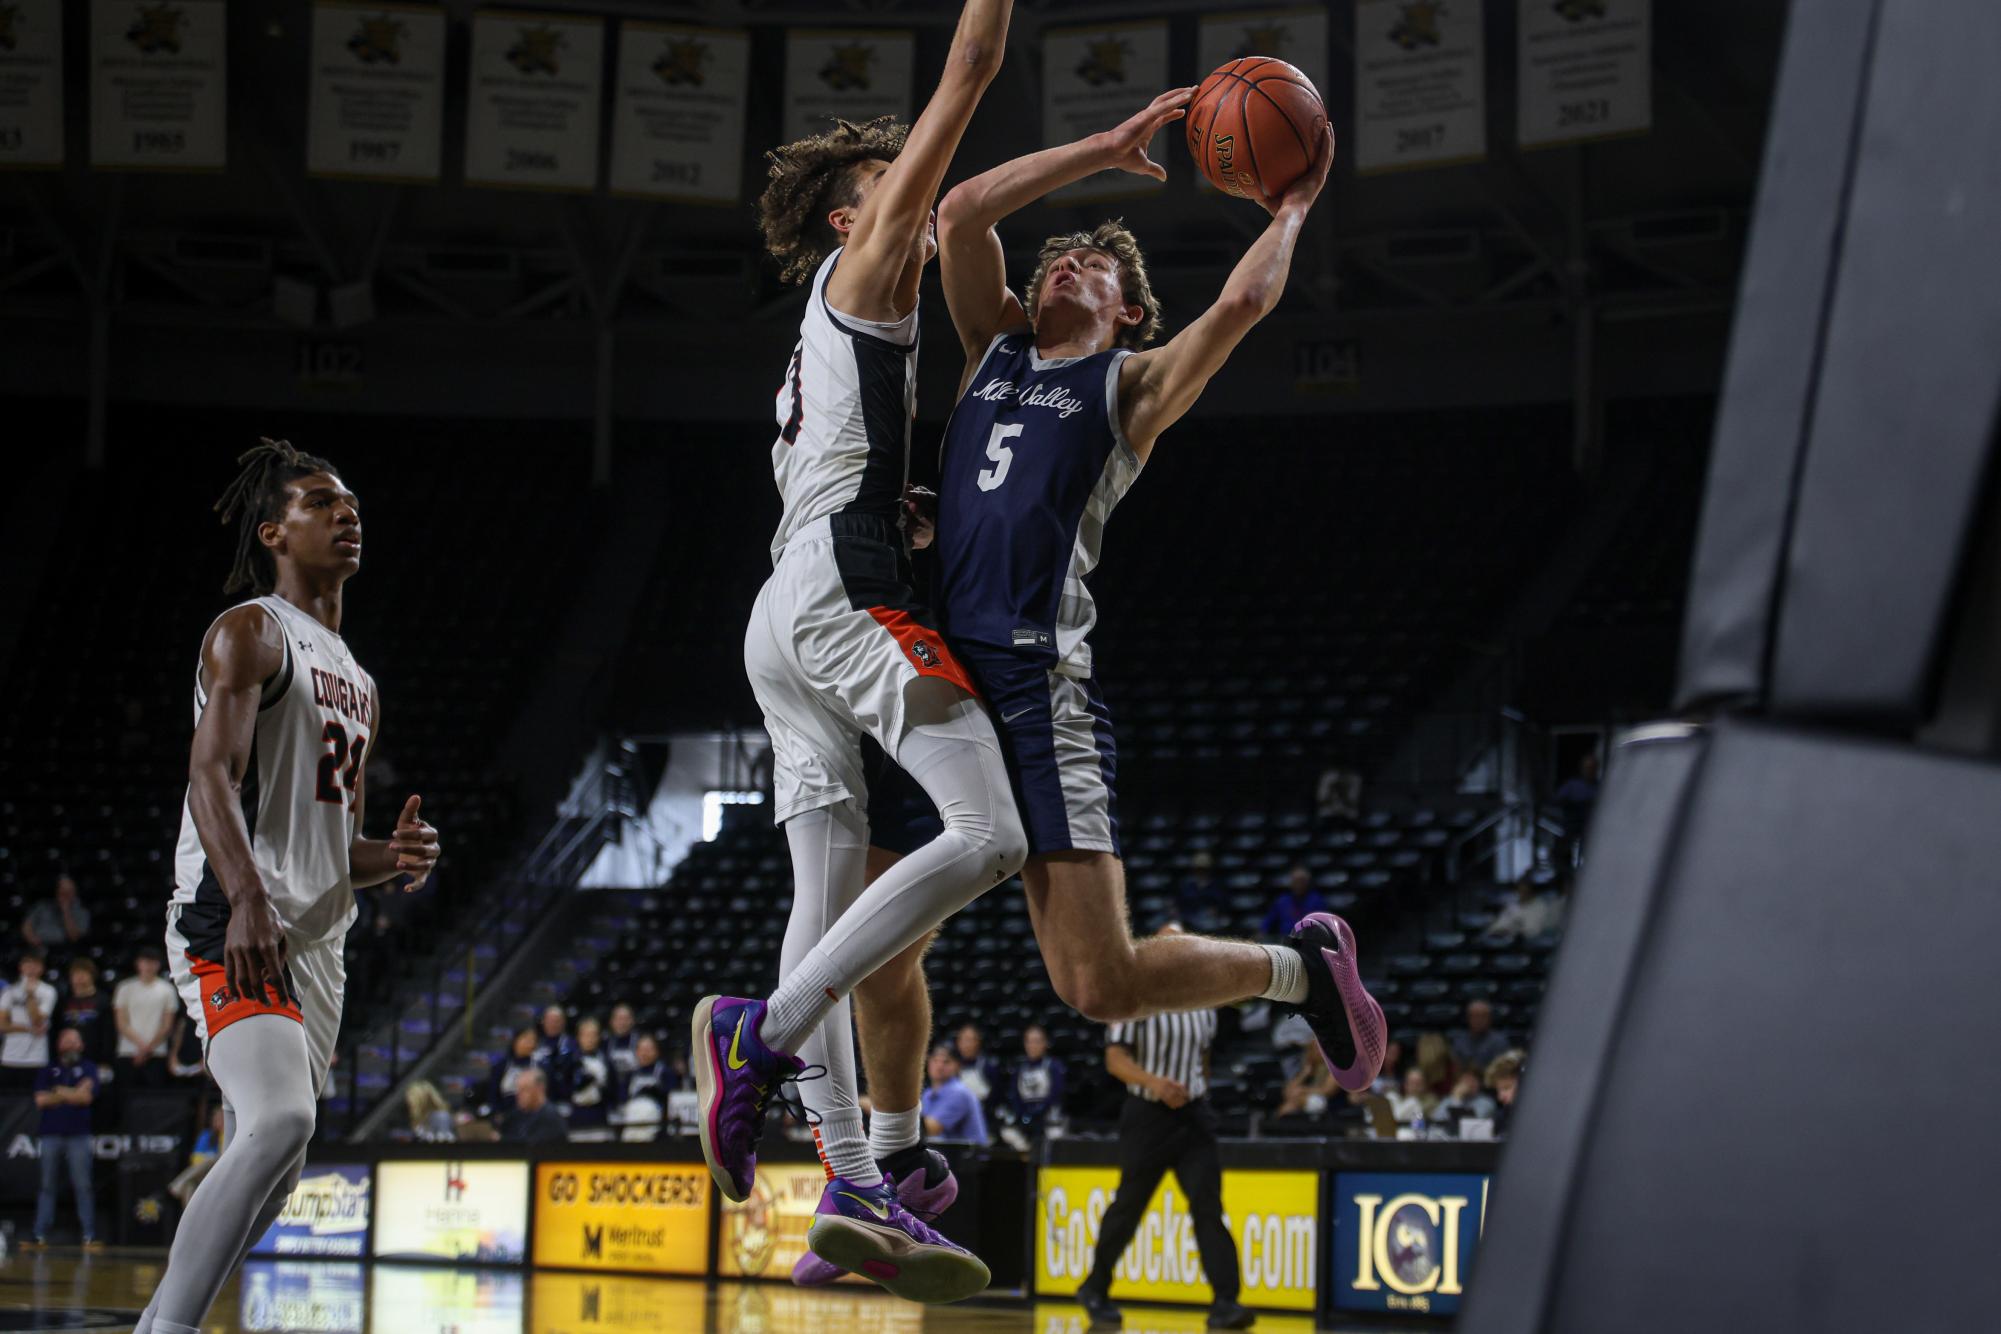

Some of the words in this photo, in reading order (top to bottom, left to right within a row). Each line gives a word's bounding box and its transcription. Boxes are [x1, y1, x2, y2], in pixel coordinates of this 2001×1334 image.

[976, 422, 1025, 493] 5
[549, 1171, 580, 1204] GO
[1351, 1192, 1469, 1295] ICI
